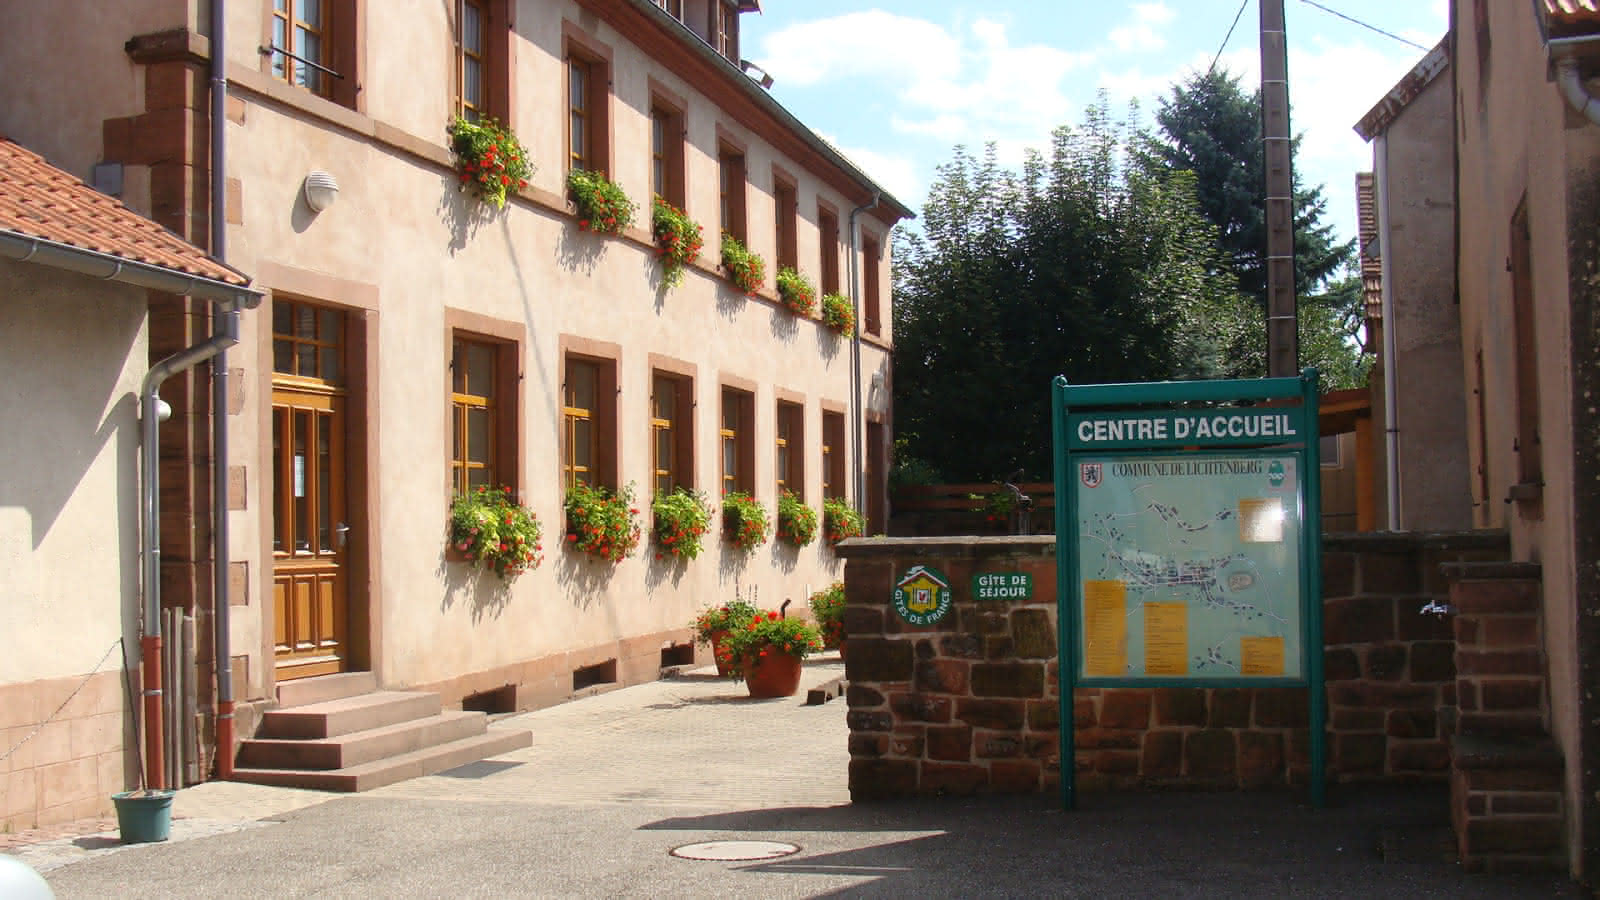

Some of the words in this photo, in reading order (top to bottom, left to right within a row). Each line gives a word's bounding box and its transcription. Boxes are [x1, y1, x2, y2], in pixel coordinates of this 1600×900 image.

[1077, 418, 1168, 441] CENTRE
[1174, 414, 1297, 439] D'ACCUEIL
[1112, 461, 1169, 477] COMMUNE
[1169, 461, 1185, 477] DE
[1185, 460, 1263, 476] LICHTENBERG
[1011, 575, 1027, 585] DE
[909, 614, 923, 625] DE
[926, 591, 950, 624] FRANCE
